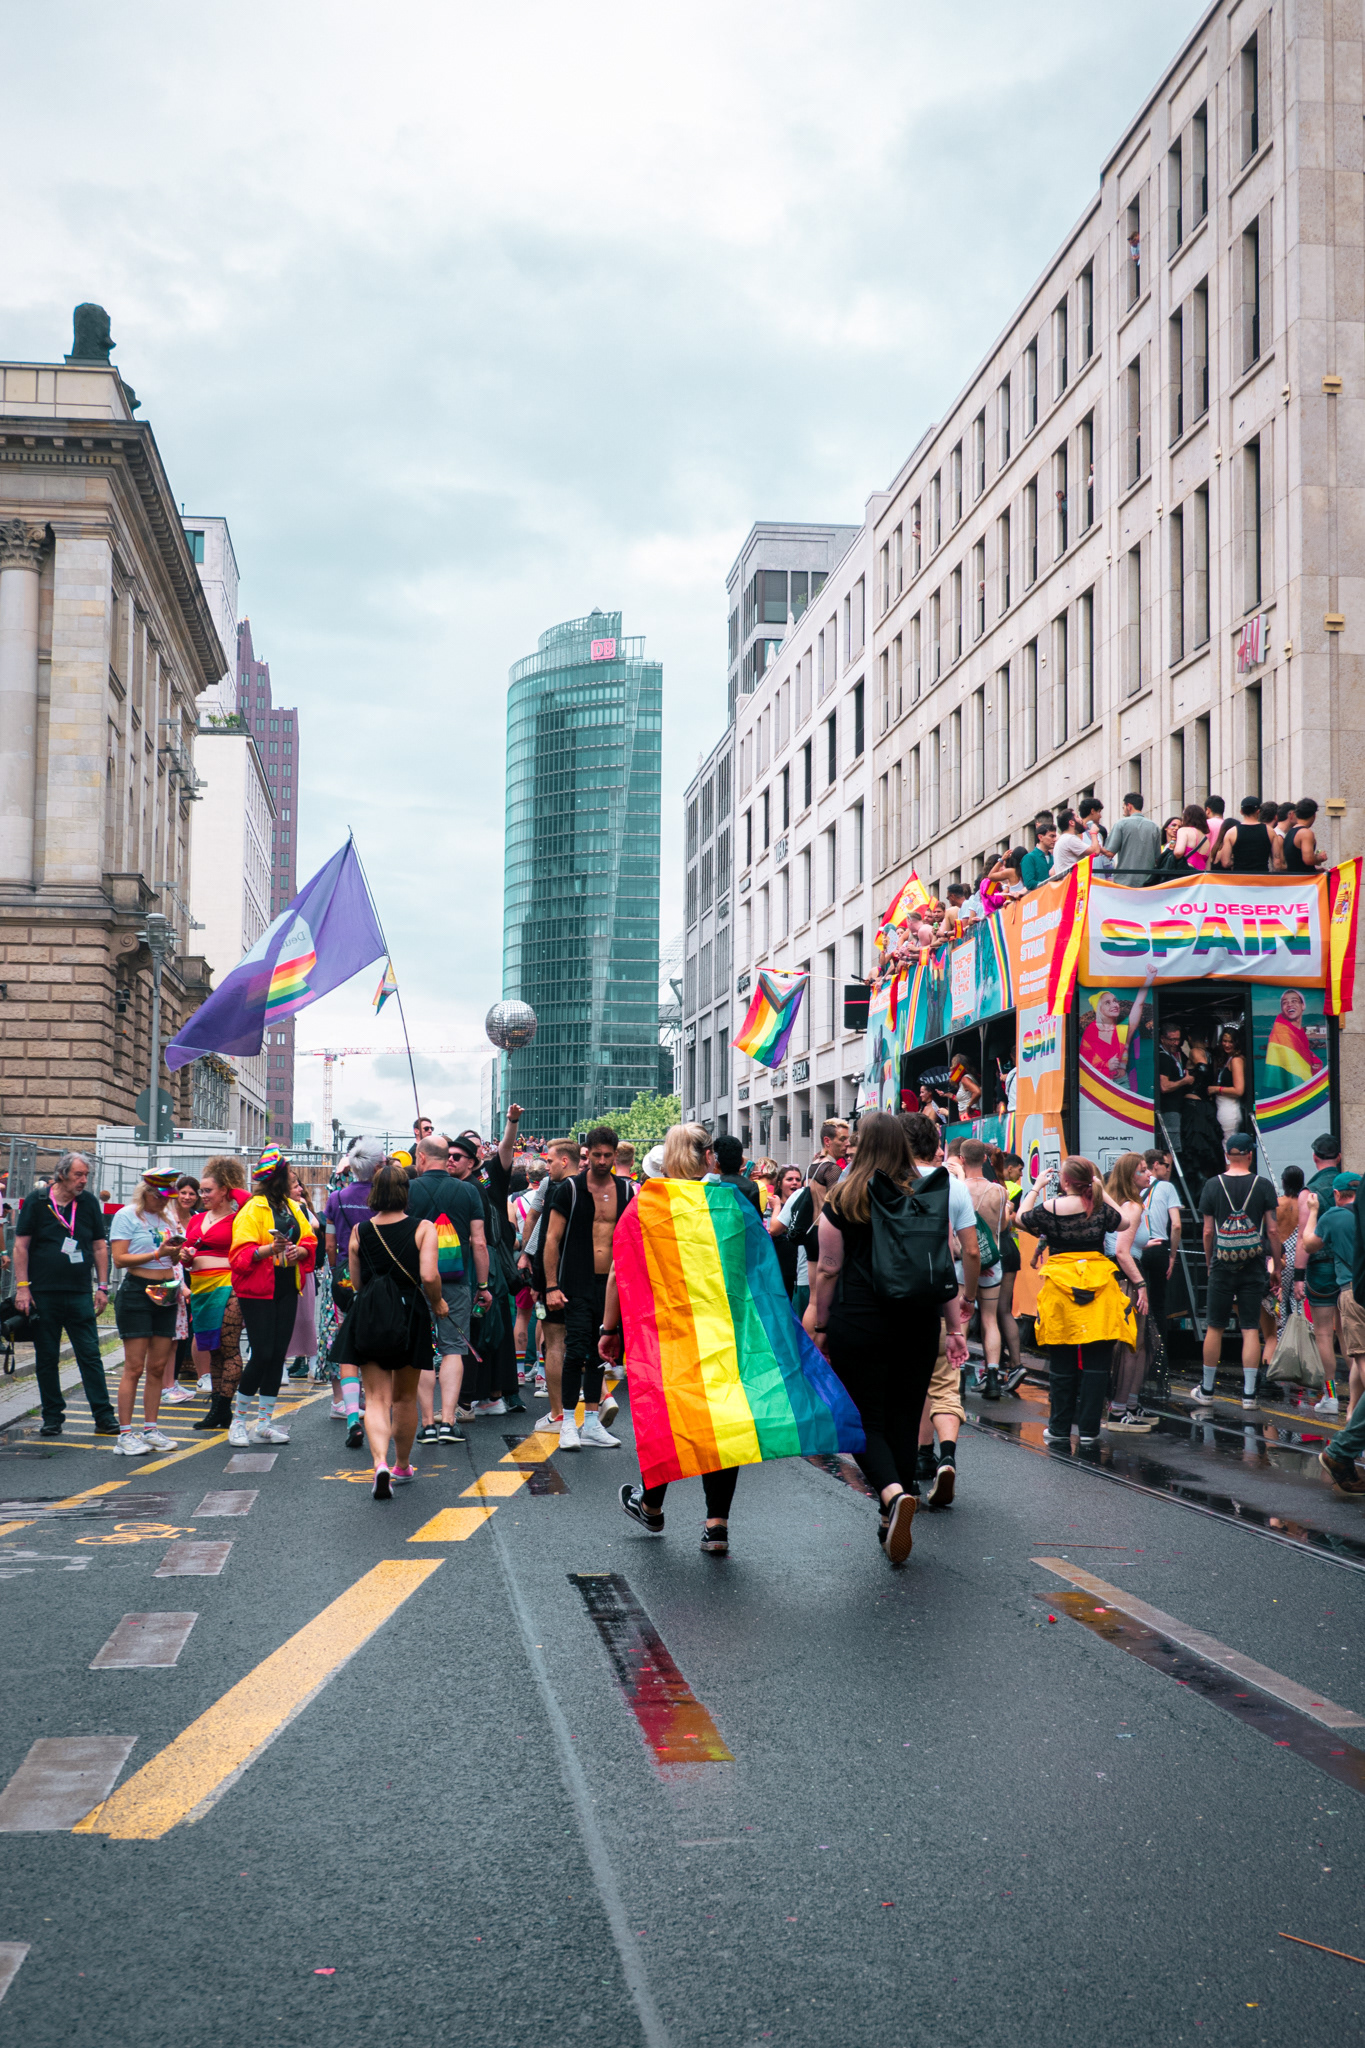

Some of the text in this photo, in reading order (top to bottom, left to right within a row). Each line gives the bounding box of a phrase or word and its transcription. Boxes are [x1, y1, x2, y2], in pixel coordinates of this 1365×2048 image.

[594, 641, 613, 657] DB
[1164, 902, 1309, 916] YOU DESERVE
[1100, 916, 1312, 958] SPAIN
[1022, 1021, 1056, 1062] SPAIN
